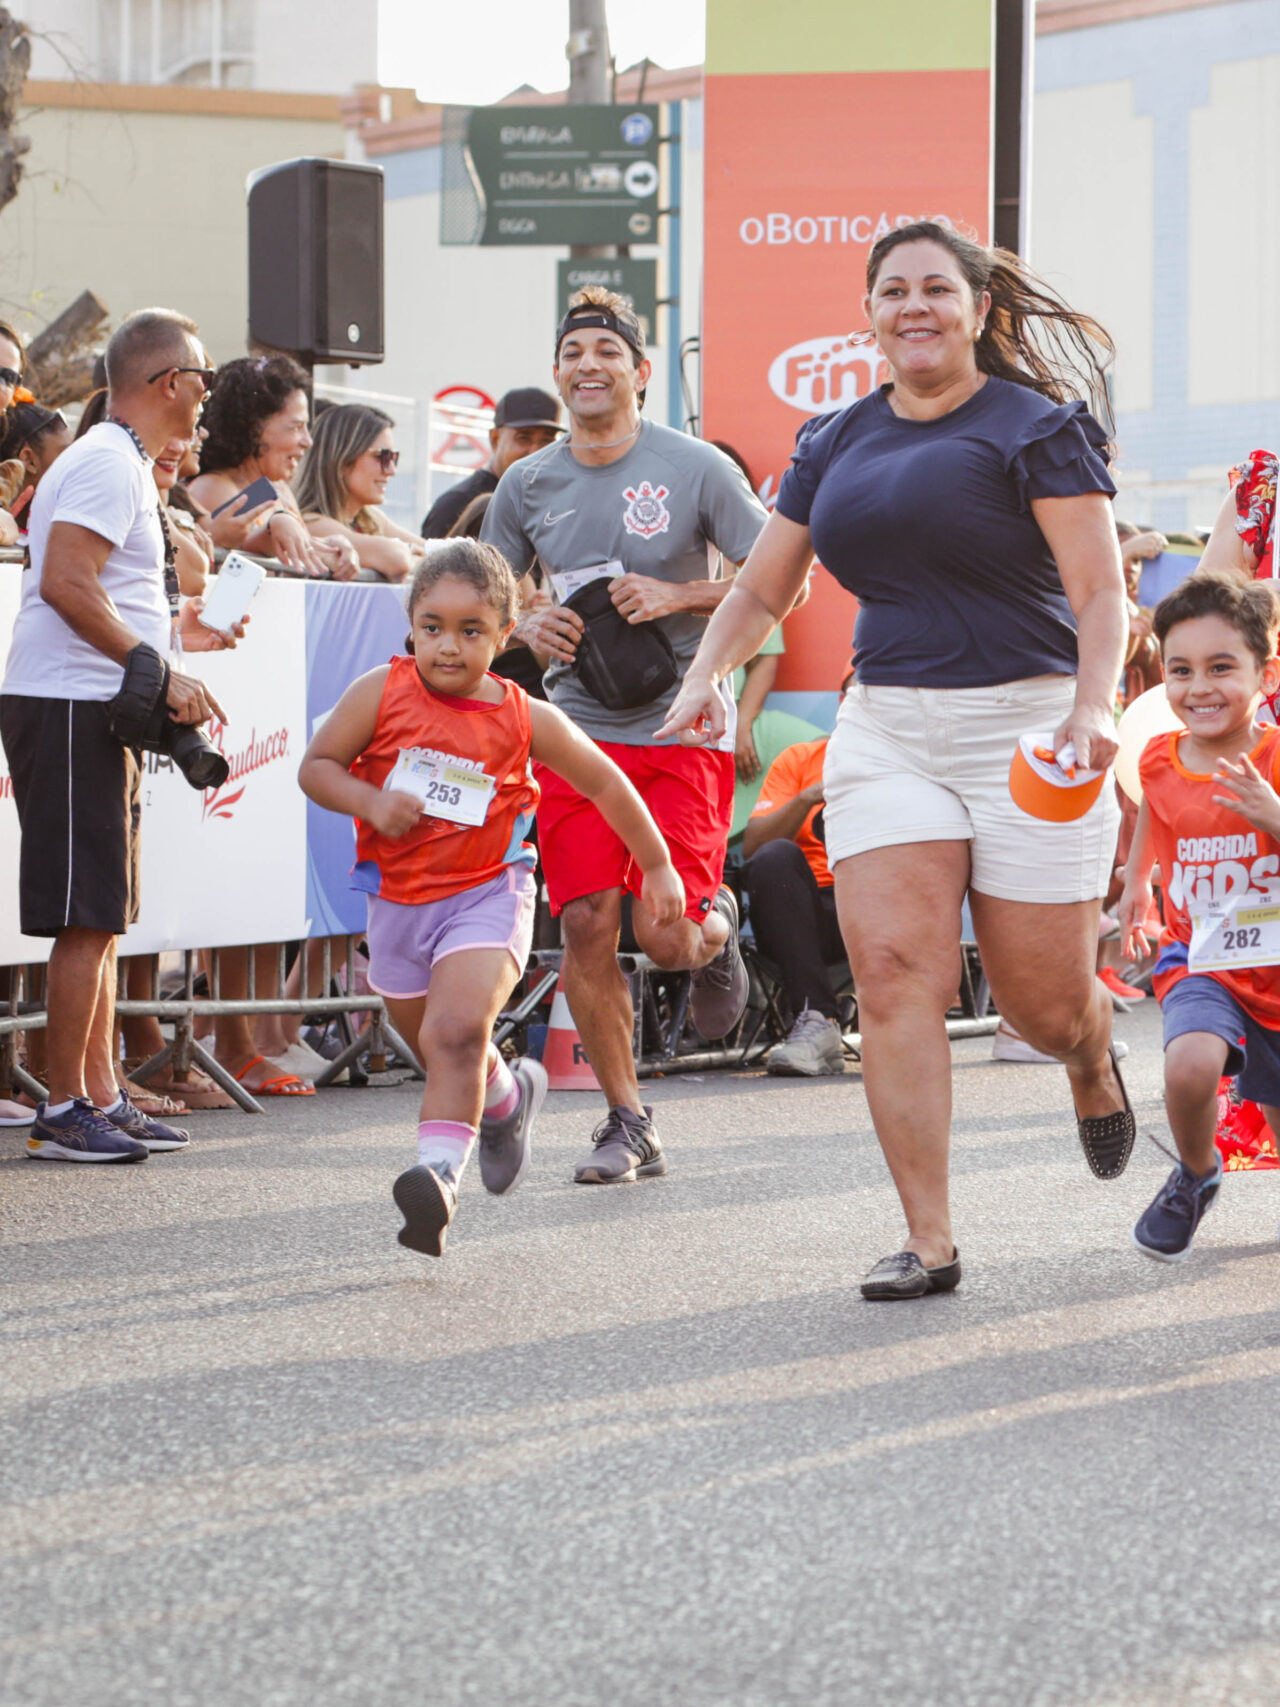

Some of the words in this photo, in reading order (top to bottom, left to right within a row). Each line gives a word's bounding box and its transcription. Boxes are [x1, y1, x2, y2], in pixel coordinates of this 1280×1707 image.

[426, 781, 462, 806] 253
[1177, 832, 1258, 862] CORRIDA
[1223, 927, 1261, 951] 282
